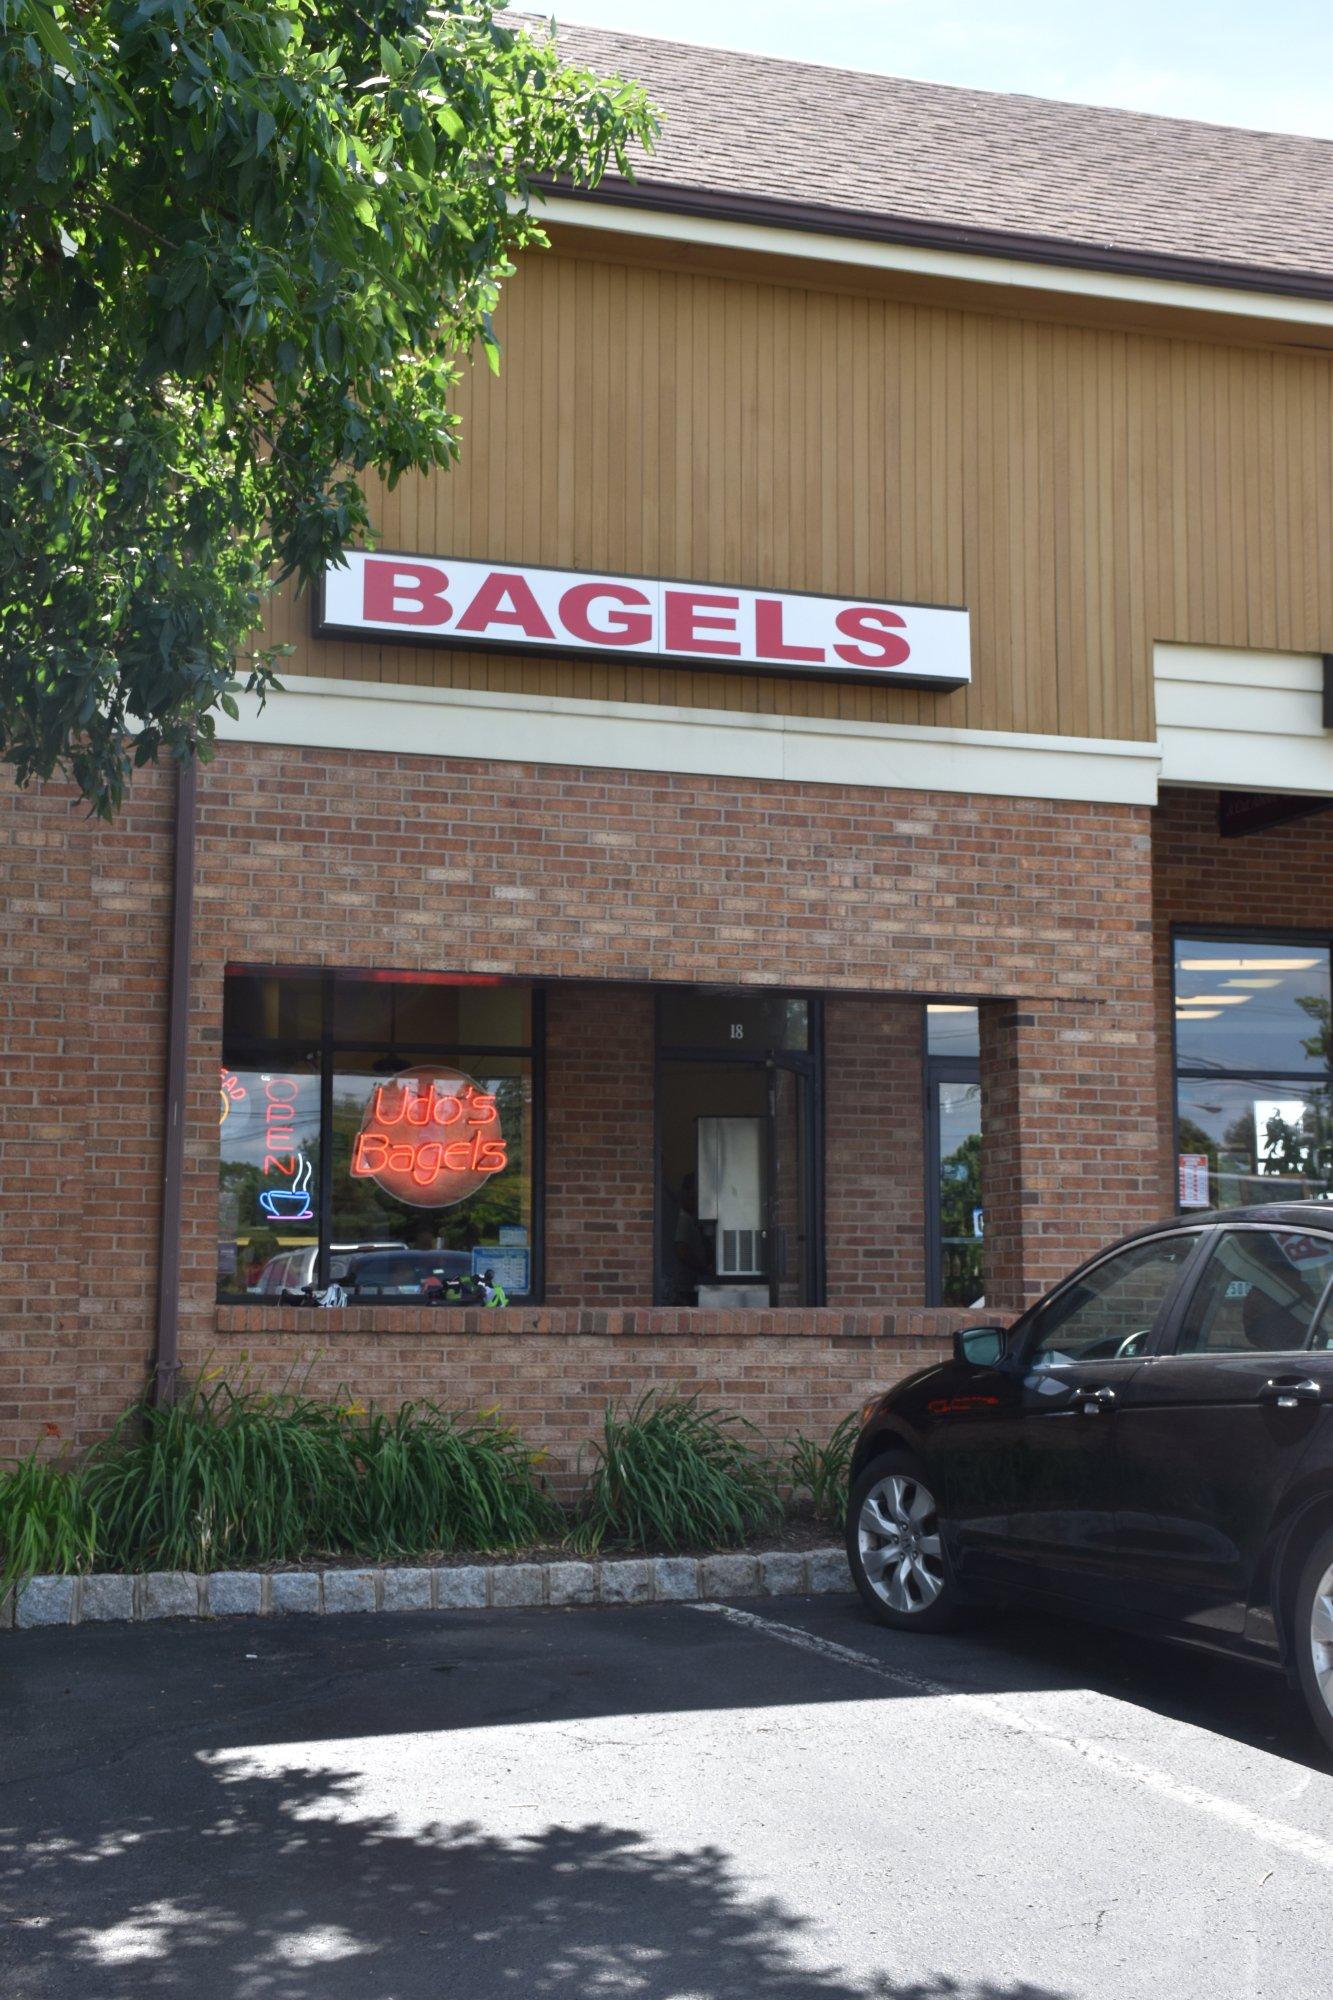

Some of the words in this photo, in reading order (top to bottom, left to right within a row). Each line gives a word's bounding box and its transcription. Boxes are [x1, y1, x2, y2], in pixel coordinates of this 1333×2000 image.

[363, 558, 910, 667] BAGELS
[730, 1024, 743, 1039] 18
[264, 1078, 299, 1176] OPEN
[375, 1085, 497, 1126] Udo's
[355, 1130, 507, 1185] Bagels
